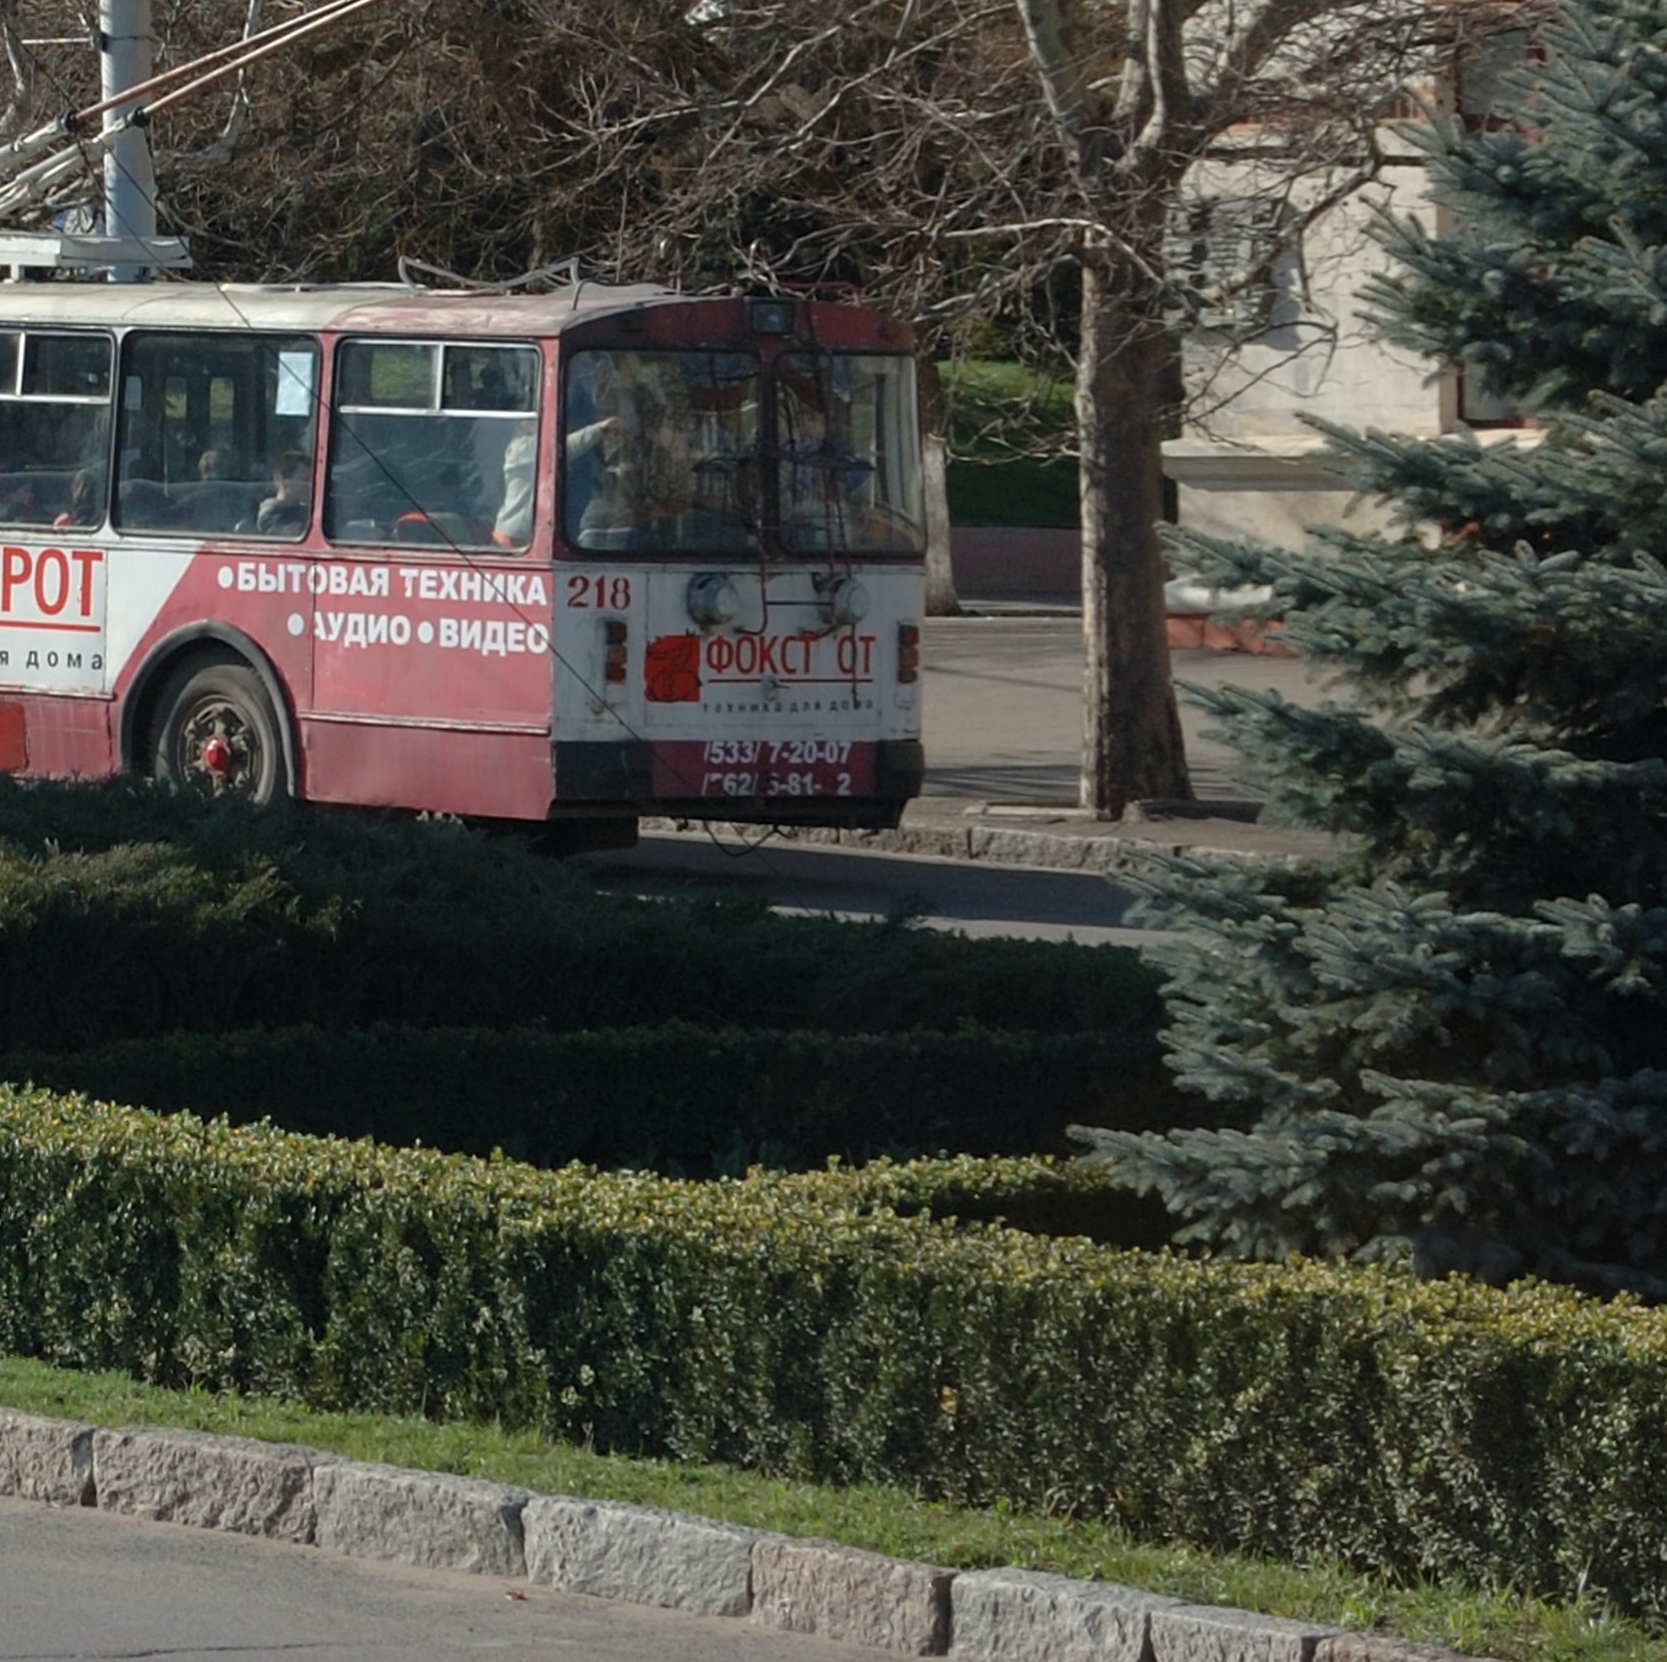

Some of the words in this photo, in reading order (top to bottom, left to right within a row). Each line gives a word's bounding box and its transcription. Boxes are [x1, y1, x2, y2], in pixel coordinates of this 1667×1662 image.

[236, 562, 390, 597] БЫТОВАЯ
[399, 568, 549, 606] ТЕХНИКА
[567, 574, 632, 611] 218
[312, 611, 411, 649] АУДИО
[439, 617, 550, 657] ВИДЕО
[26, 649, 104, 671] дома
[706, 635, 876, 675] ФОКСТОТ
[829, 698, 874, 712] доа
[703, 740, 760, 764] /533/
[768, 740, 852, 764] 7-20-07
